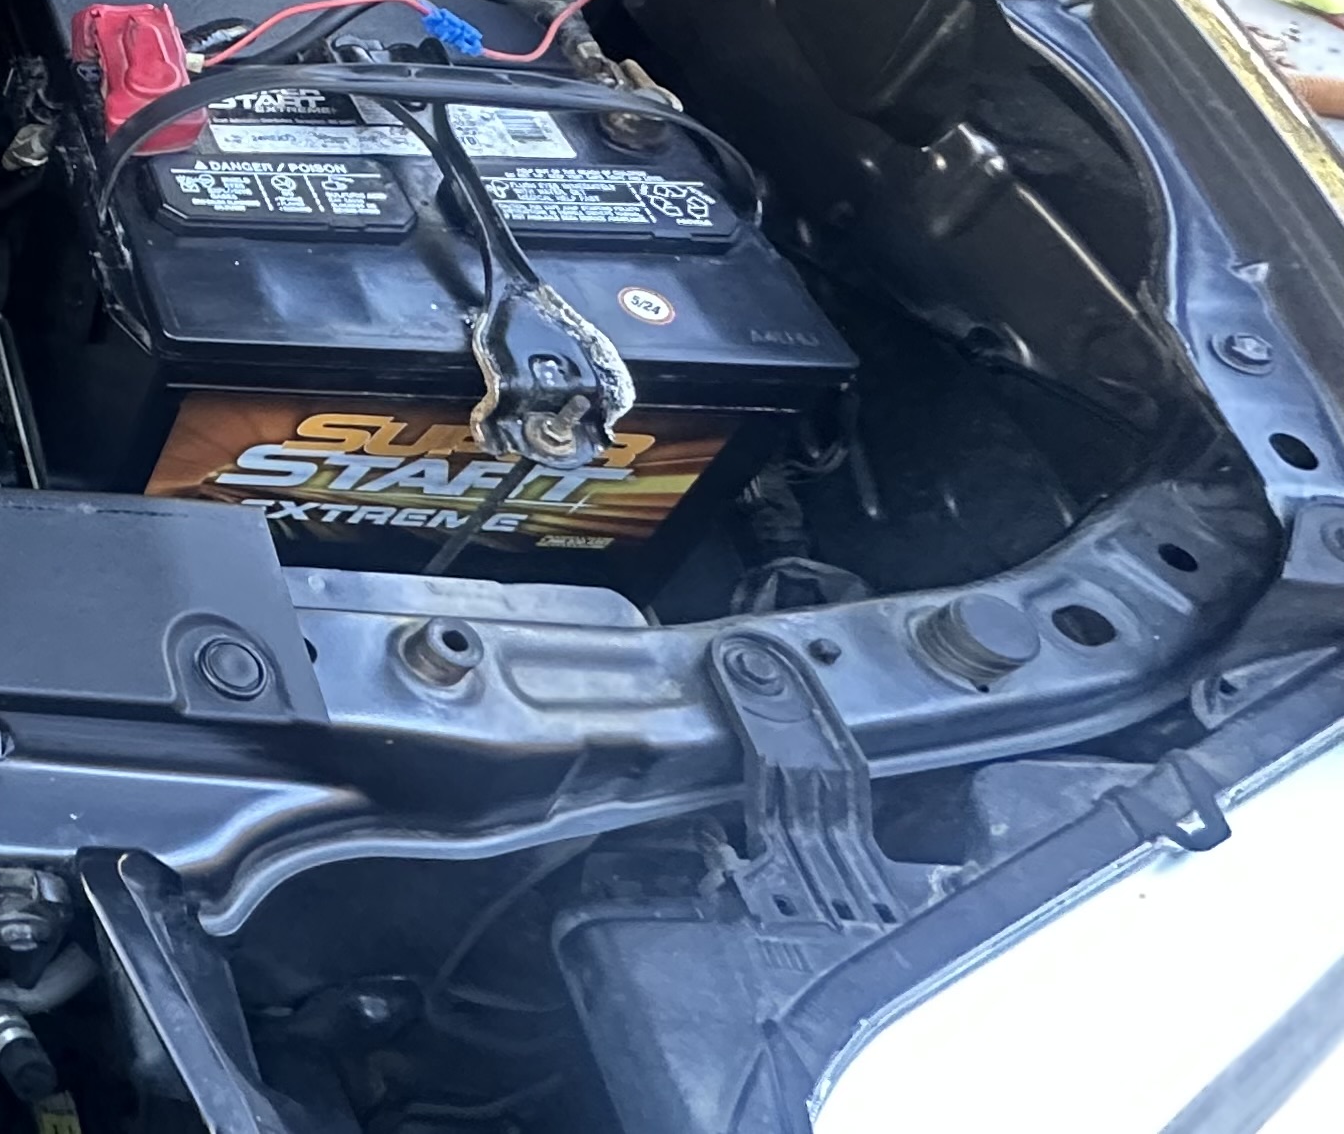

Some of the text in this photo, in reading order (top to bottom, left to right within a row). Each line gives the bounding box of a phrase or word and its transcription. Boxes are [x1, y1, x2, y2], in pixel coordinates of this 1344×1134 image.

[209, 160, 274, 173] DANGER
[288, 162, 348, 174] POISON
[630, 295, 661, 315] 5/24
